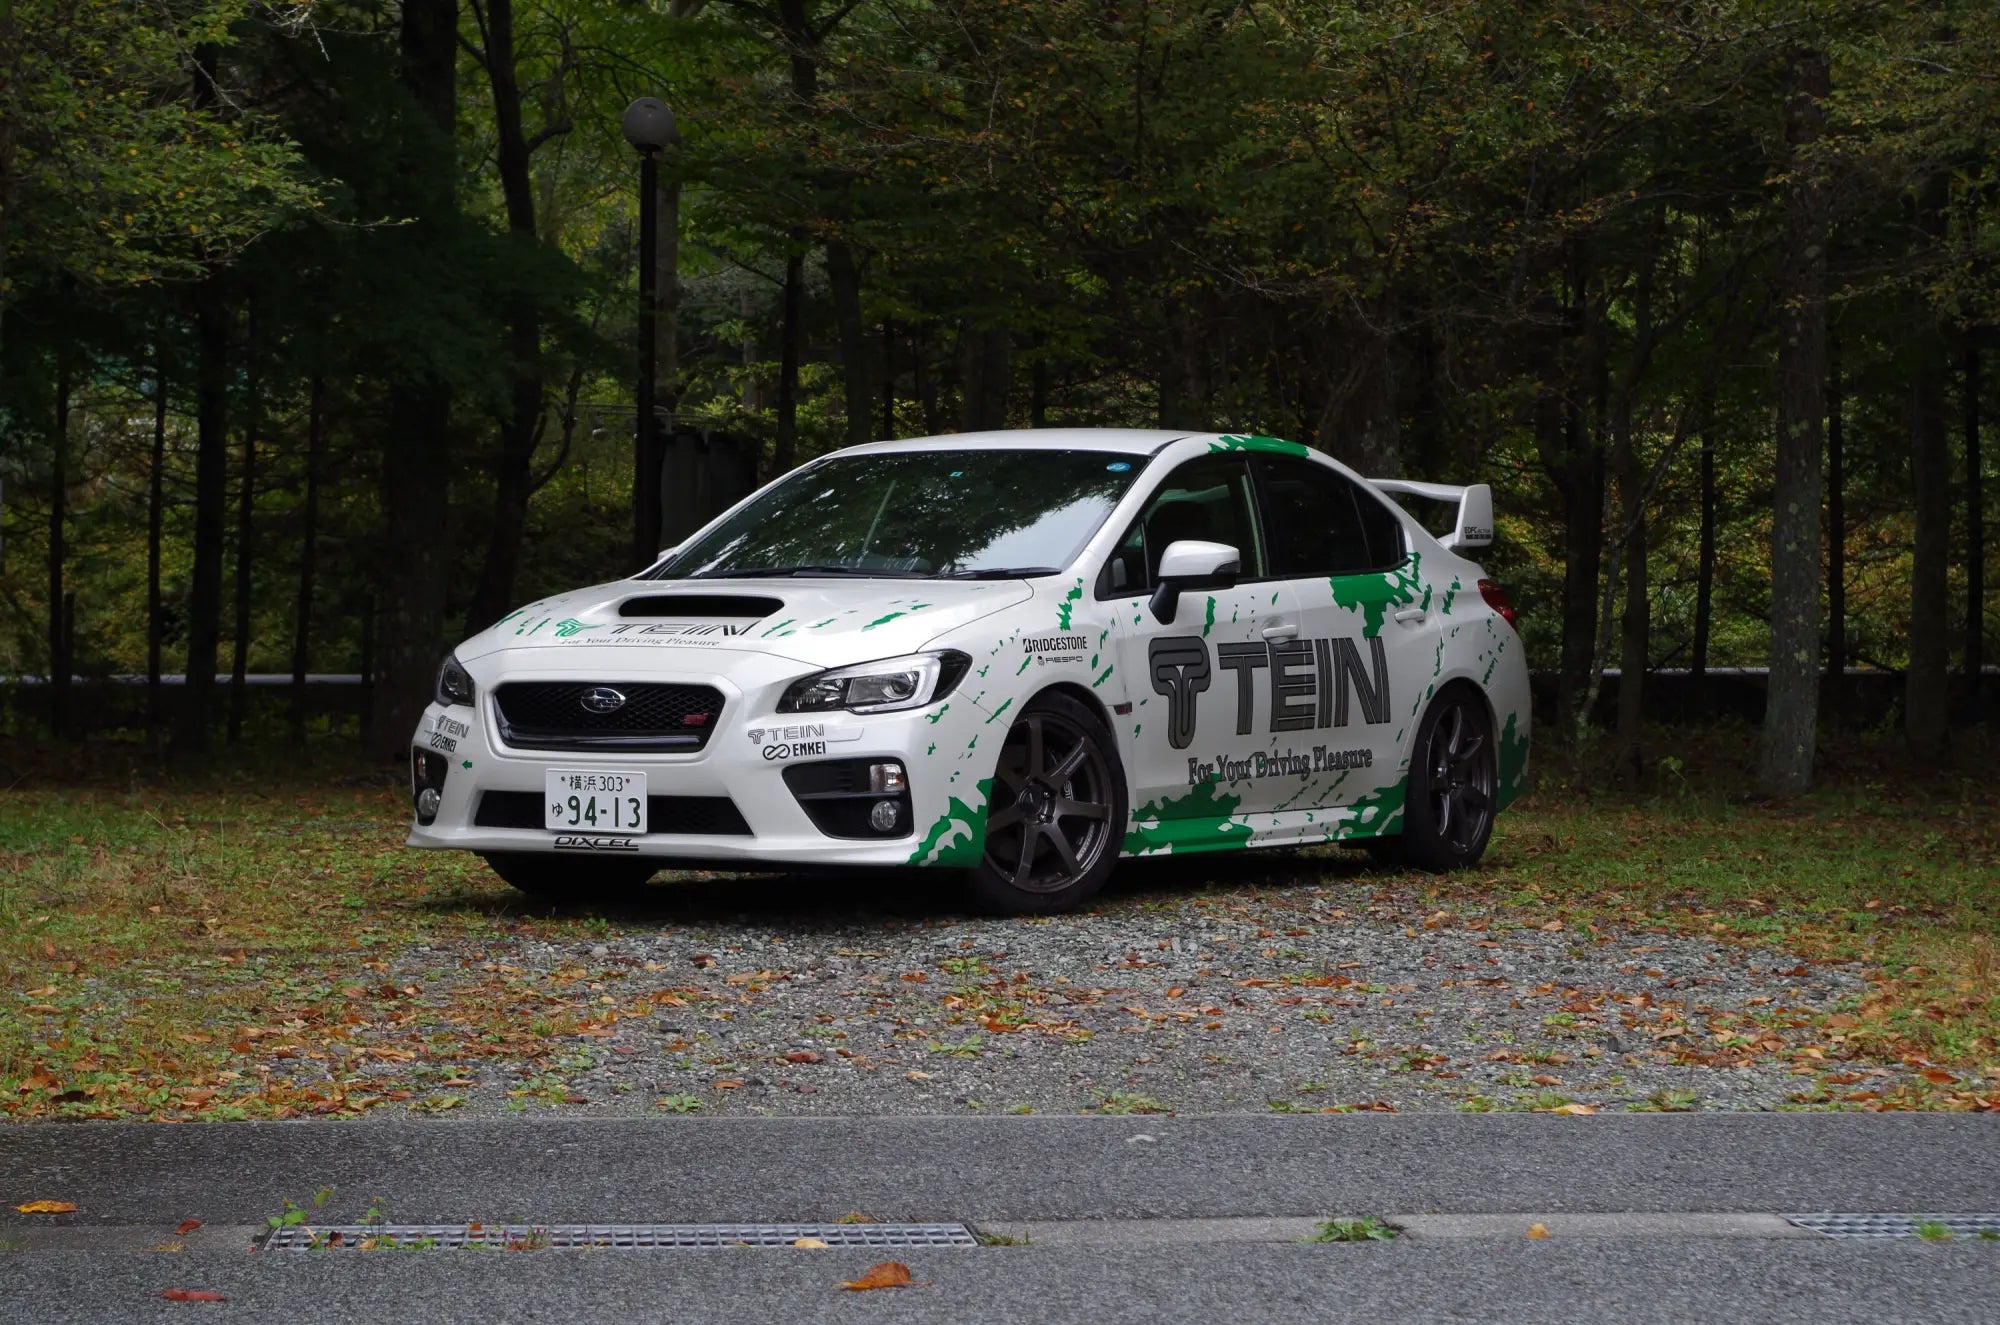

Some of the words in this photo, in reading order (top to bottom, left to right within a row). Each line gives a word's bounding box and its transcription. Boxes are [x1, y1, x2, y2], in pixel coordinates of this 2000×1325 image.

[610, 620, 762, 637] TEIN
[586, 636, 614, 645] Your
[615, 636, 663, 646] Driving
[665, 637, 720, 647] Pleasure
[1023, 636, 1088, 653] BRIDGESTONE
[1217, 636, 1391, 736] TEIN
[444, 718, 470, 739] TEIN
[767, 723, 825, 742] TEIN
[792, 741, 826, 757] ENKEI
[1188, 757, 1215, 785] For
[1216, 754, 1252, 782] Your
[1254, 747, 1312, 781] Driving
[1312, 744, 1373, 773] Pleasure
[569, 775, 597, 791] 横浜
[599, 776, 623, 792] 303
[551, 802, 563, 817] ゆ
[567, 795, 641, 828] 94-13
[554, 836, 639, 851] DIXCEL
